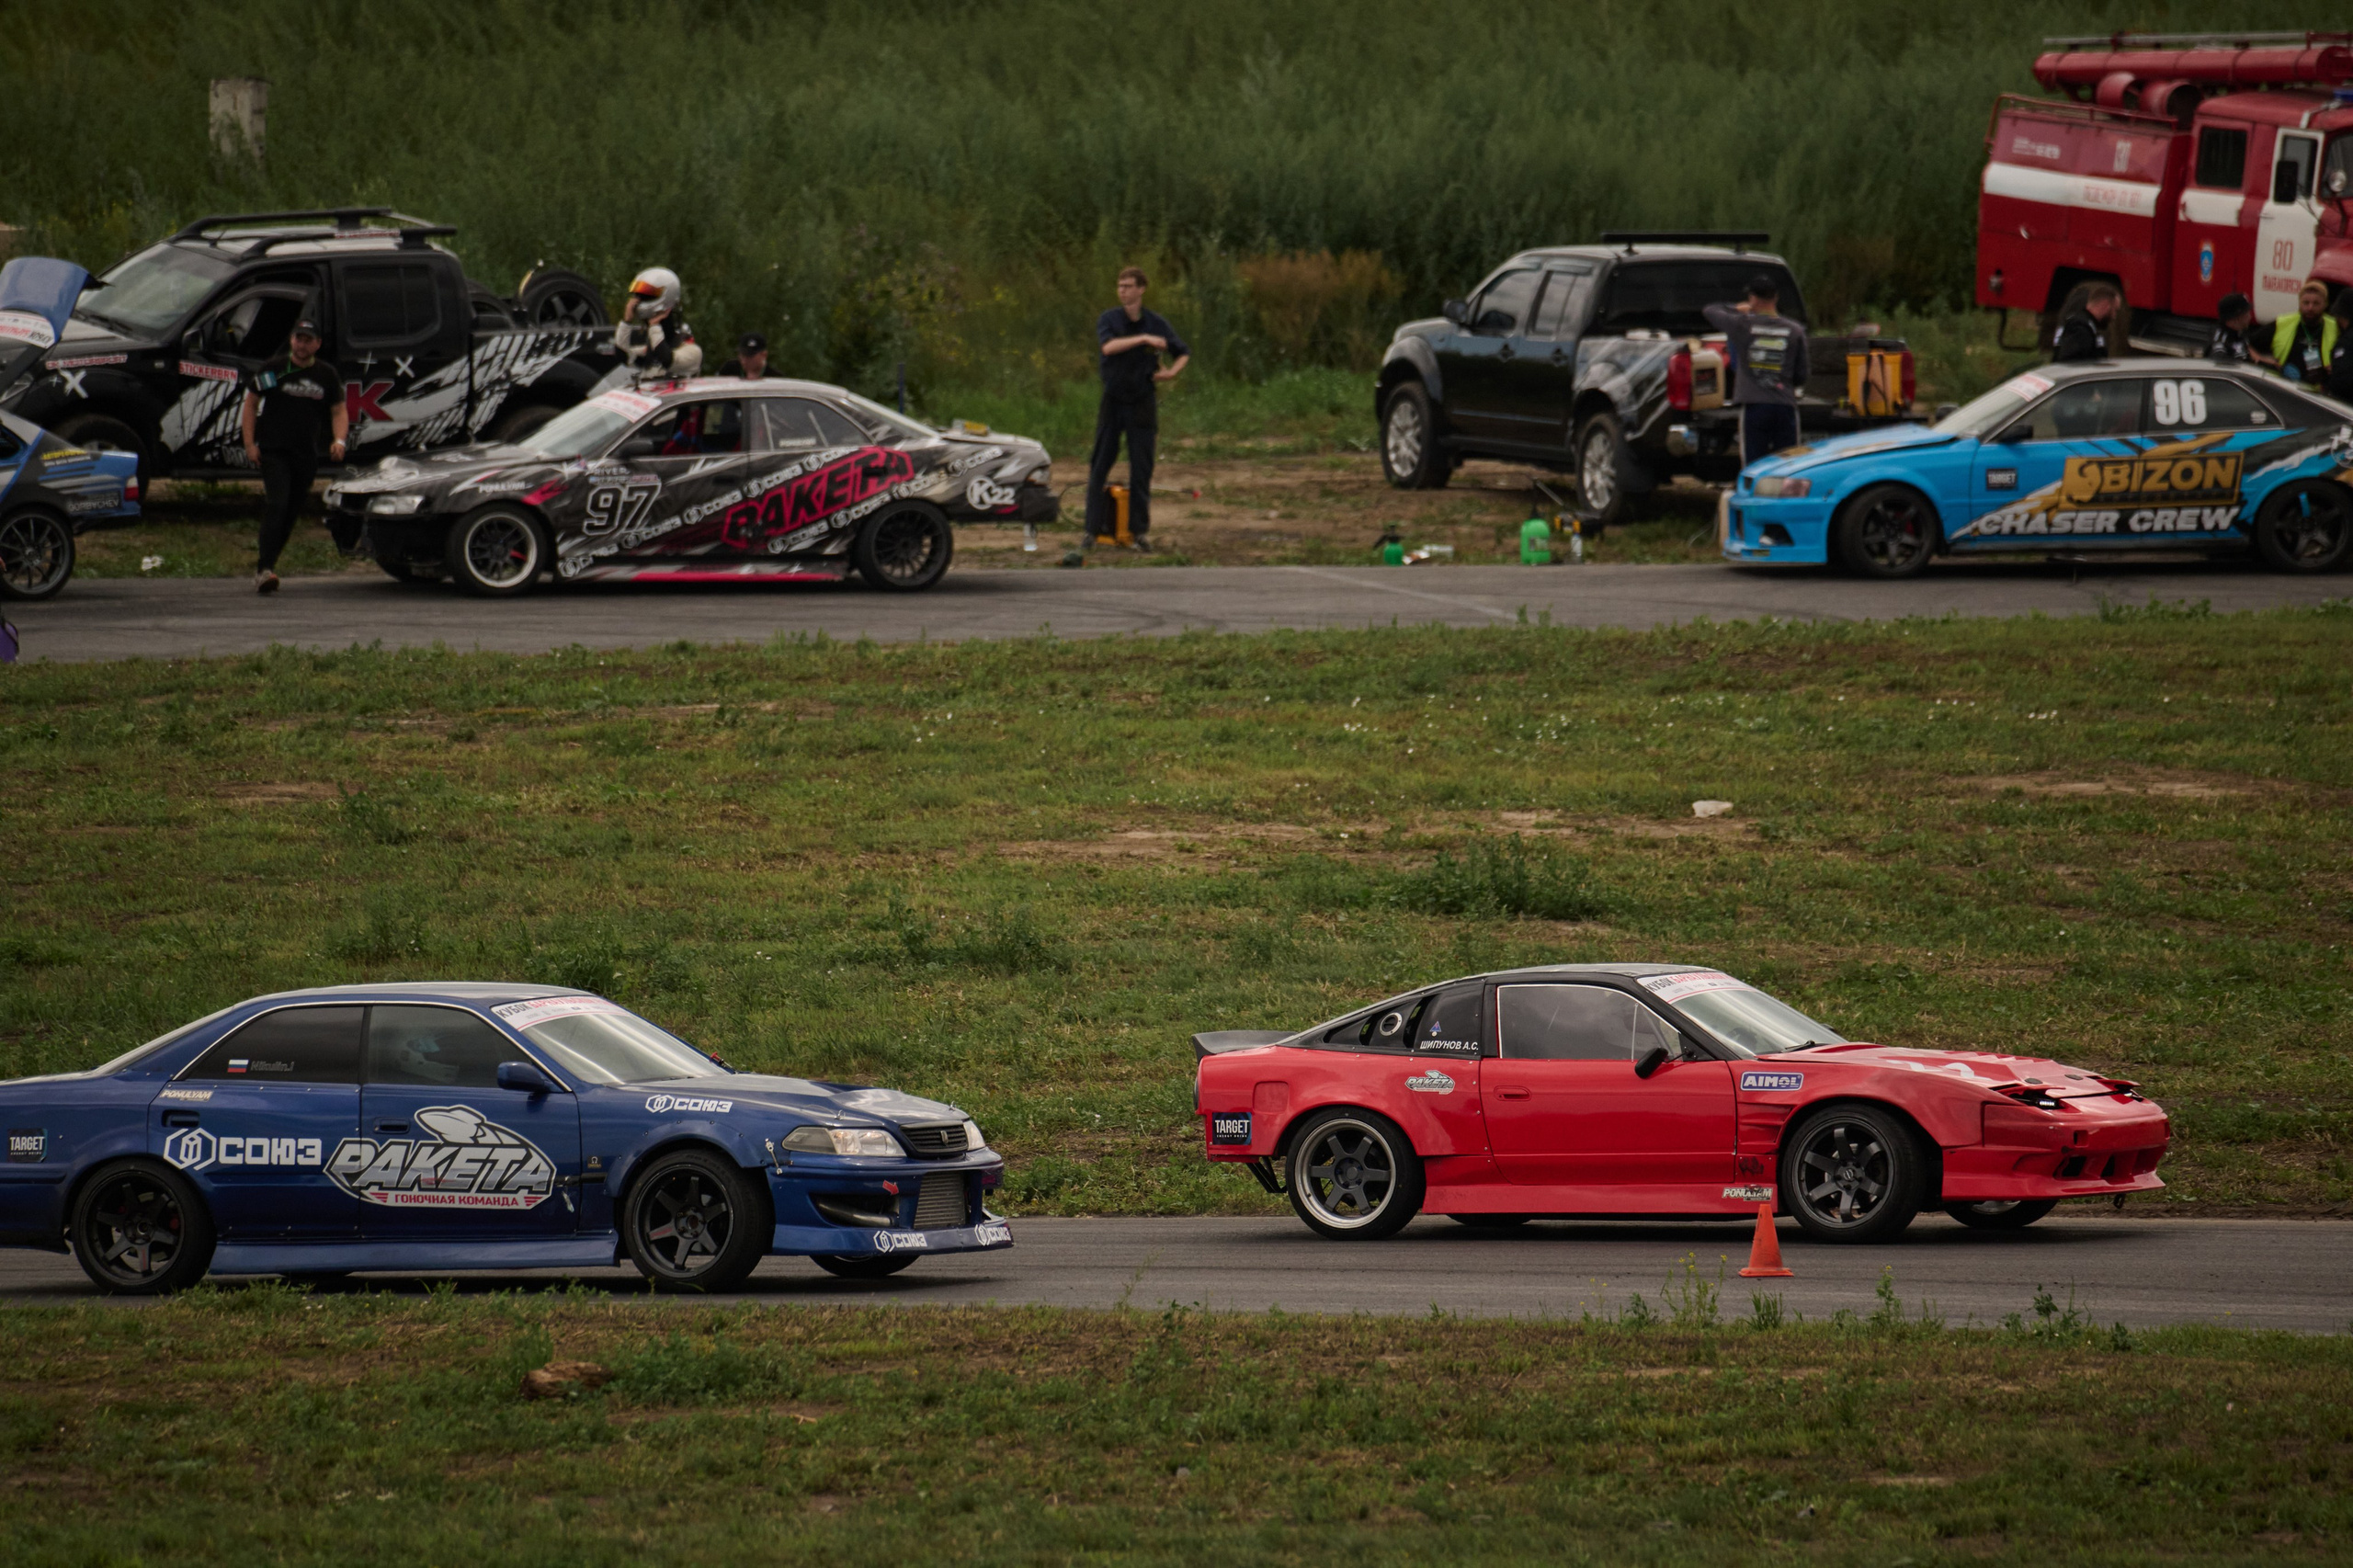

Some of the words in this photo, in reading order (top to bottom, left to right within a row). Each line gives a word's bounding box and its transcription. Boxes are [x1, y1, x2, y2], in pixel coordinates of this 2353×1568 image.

[2272, 239, 2294, 271] 80
[2153, 378, 2208, 426] 96
[2099, 457, 2237, 494] BIZON
[583, 483, 662, 536] 97
[1976, 509, 2120, 536] CHASER
[2129, 505, 2241, 533] CREW
[1645, 977, 1677, 993] КУБОК
[496, 1002, 532, 1019] КУБОК
[1420, 1040, 1461, 1050] ШИПУНОВ
[1462, 1040, 1479, 1051] А.С.
[1743, 1075, 1800, 1088] AIMOL
[673, 1097, 733, 1114] СОЮЗ
[1214, 1119, 1250, 1134] TARGET
[9, 1136, 45, 1152] TARGET
[218, 1136, 323, 1165] СОЮЗ
[394, 1193, 456, 1206] ГОНОЧНАЯ
[458, 1194, 519, 1207] КОМАНДА
[892, 1233, 928, 1248] СОЮЗ
